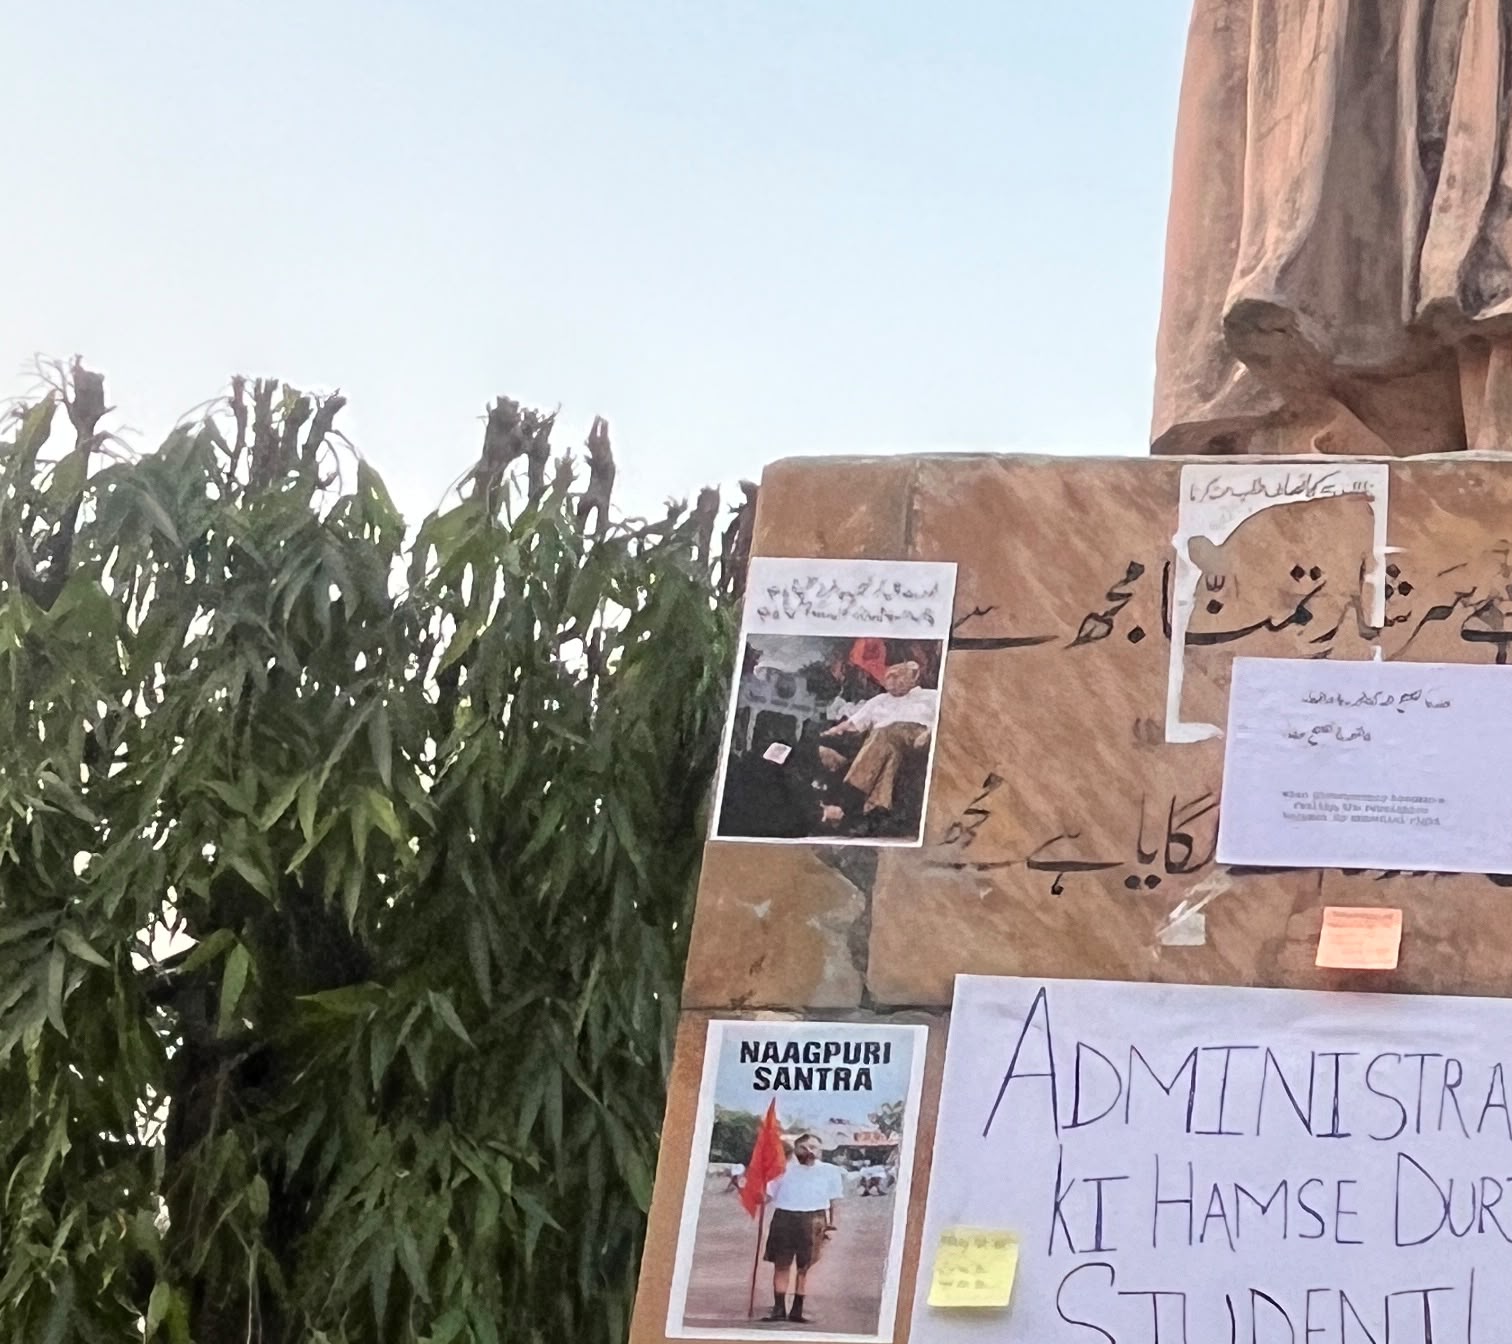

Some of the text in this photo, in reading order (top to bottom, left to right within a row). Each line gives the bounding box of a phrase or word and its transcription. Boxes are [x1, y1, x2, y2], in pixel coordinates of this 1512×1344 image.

[740, 1040, 892, 1065] NAAGPURI
[753, 1067, 873, 1091] SANTRA
[1048, 1144, 1130, 1256] KI
[1153, 1153, 1363, 1253] HAMSE
